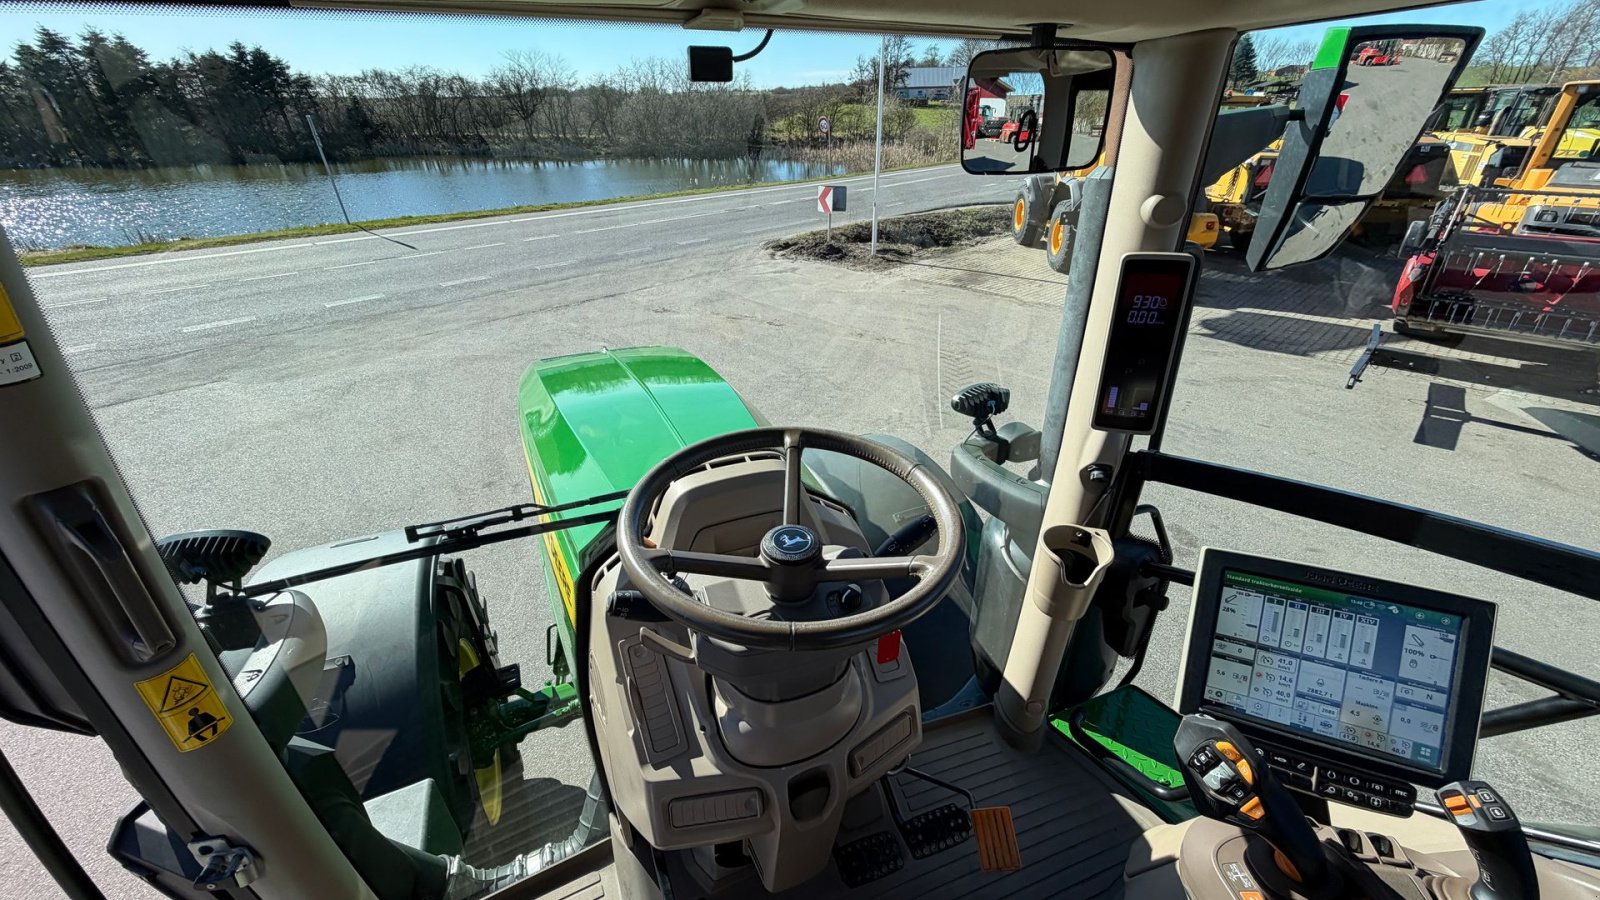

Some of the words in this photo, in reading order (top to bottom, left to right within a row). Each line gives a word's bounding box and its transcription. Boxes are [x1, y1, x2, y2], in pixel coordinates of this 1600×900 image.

[1132, 294, 1161, 309] 930
[1226, 573, 1251, 583] Standard
[1360, 617, 1376, 625] XIV
[1403, 647, 1425, 657] 100%
